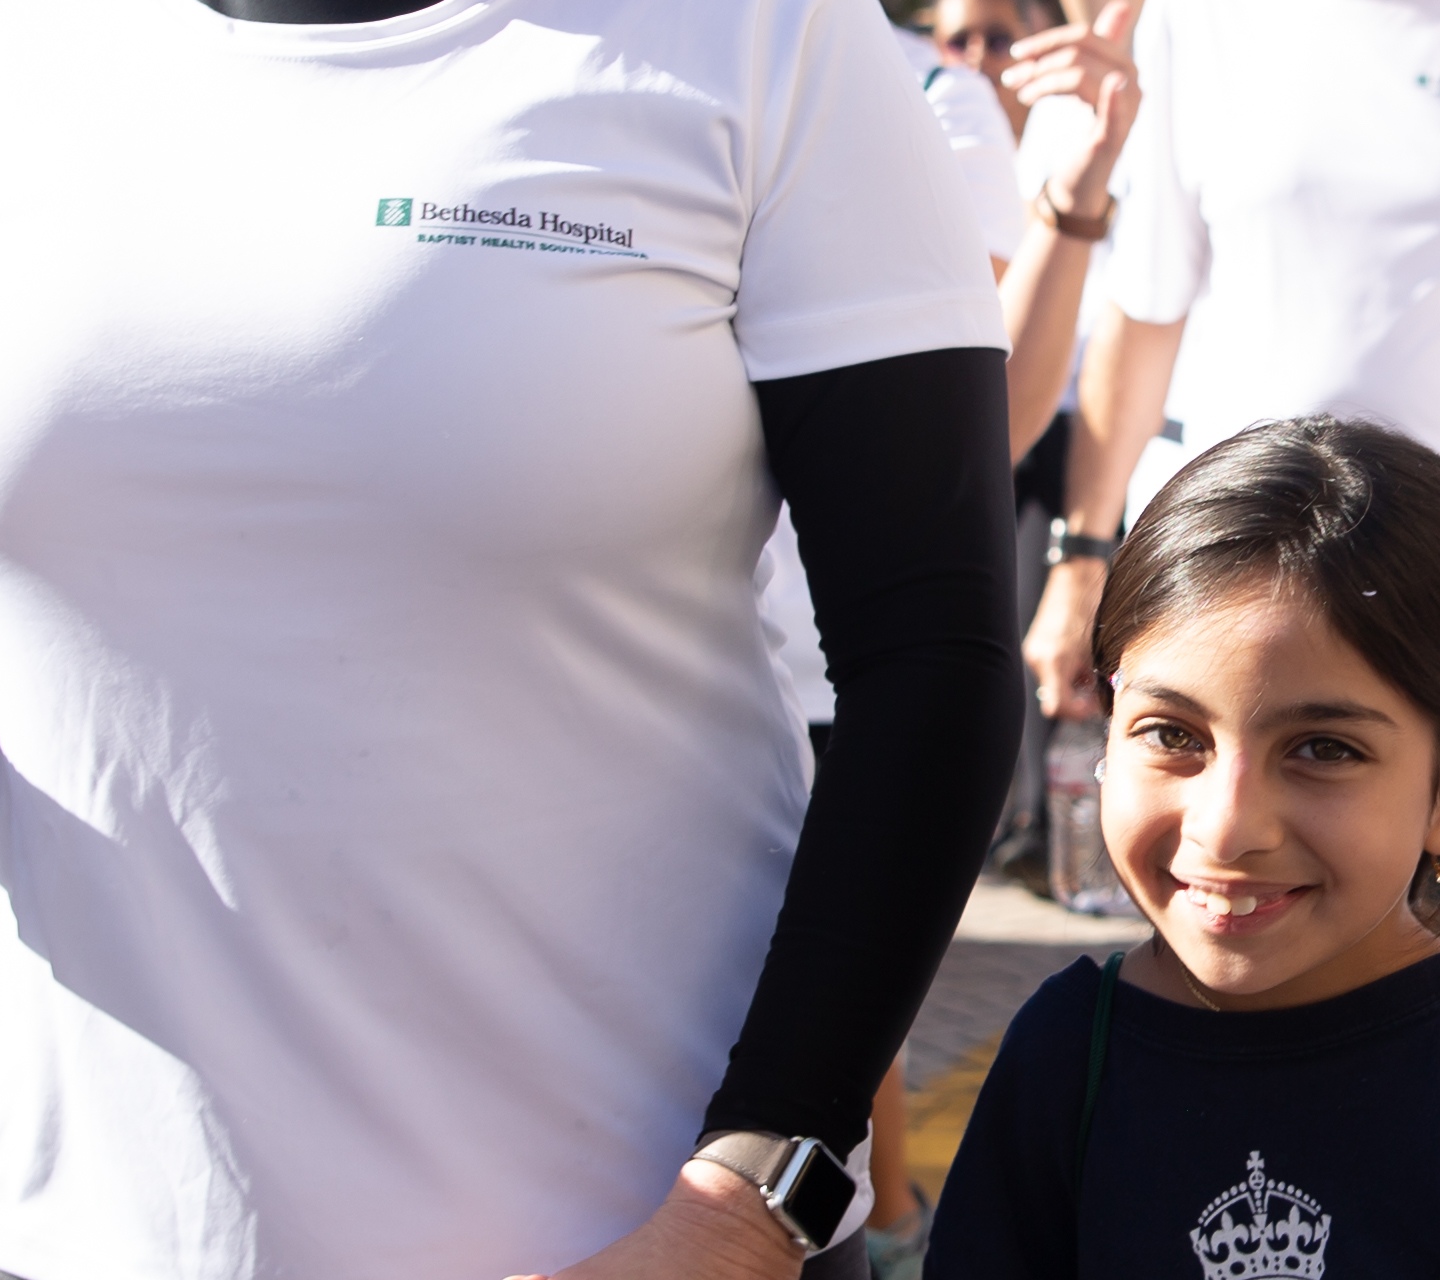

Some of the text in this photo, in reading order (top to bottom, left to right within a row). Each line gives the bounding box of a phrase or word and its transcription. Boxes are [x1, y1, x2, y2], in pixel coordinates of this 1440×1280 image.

[420, 201, 634, 249] Bethesda Hospital
[480, 236, 536, 252] HEALTH
